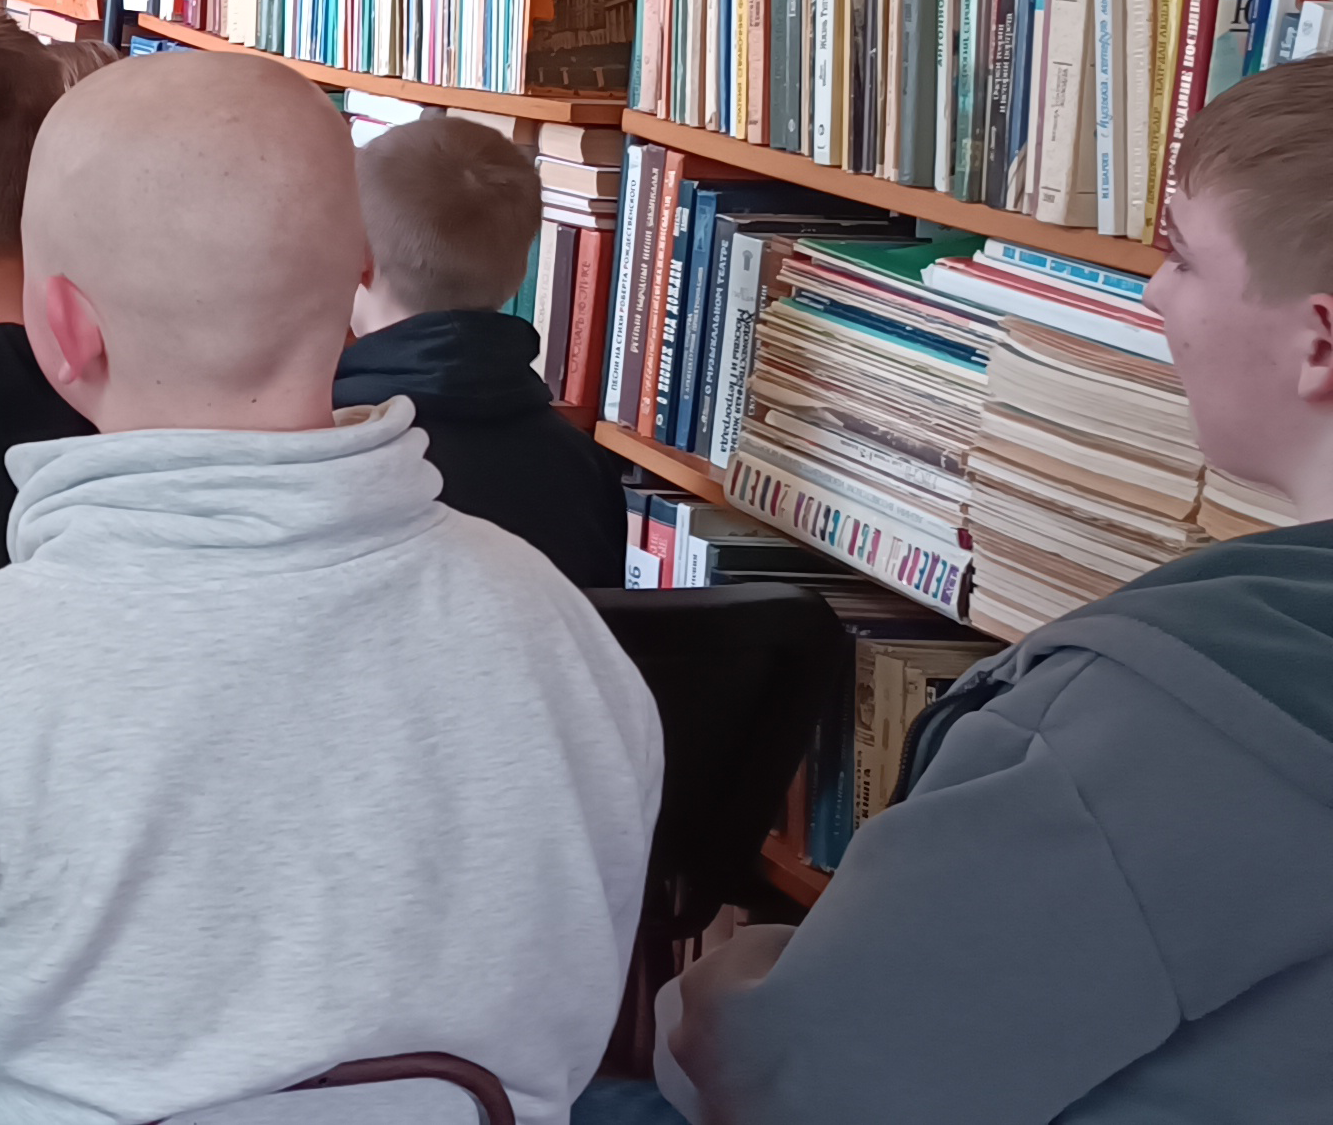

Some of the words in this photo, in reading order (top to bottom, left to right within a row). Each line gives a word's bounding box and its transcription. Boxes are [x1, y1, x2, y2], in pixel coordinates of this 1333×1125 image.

[1099, 19, 1111, 75] которую
[1173, 69, 1193, 139] РОДИНЕ
[623, 179, 637, 269] РОЖДЕСТВЕНСКОГО
[715, 239, 729, 285] ТЕАТРЕ
[619, 271, 629, 313] РОБЕРТА
[613, 345, 621, 359] НА
[615, 315, 625, 345] СТИХИ
[661, 319, 679, 343] ПОД
[705, 287, 723, 383] МУЗЫКАЛЬНОМ
[731, 307, 747, 359] Москвы
[611, 361, 619, 391] ПЕСНИ
[657, 345, 673, 393] ПЕСНЯХ
[703, 385, 713, 395] О
[655, 397, 669, 405] О
[719, 373, 739, 453] Петрограда
